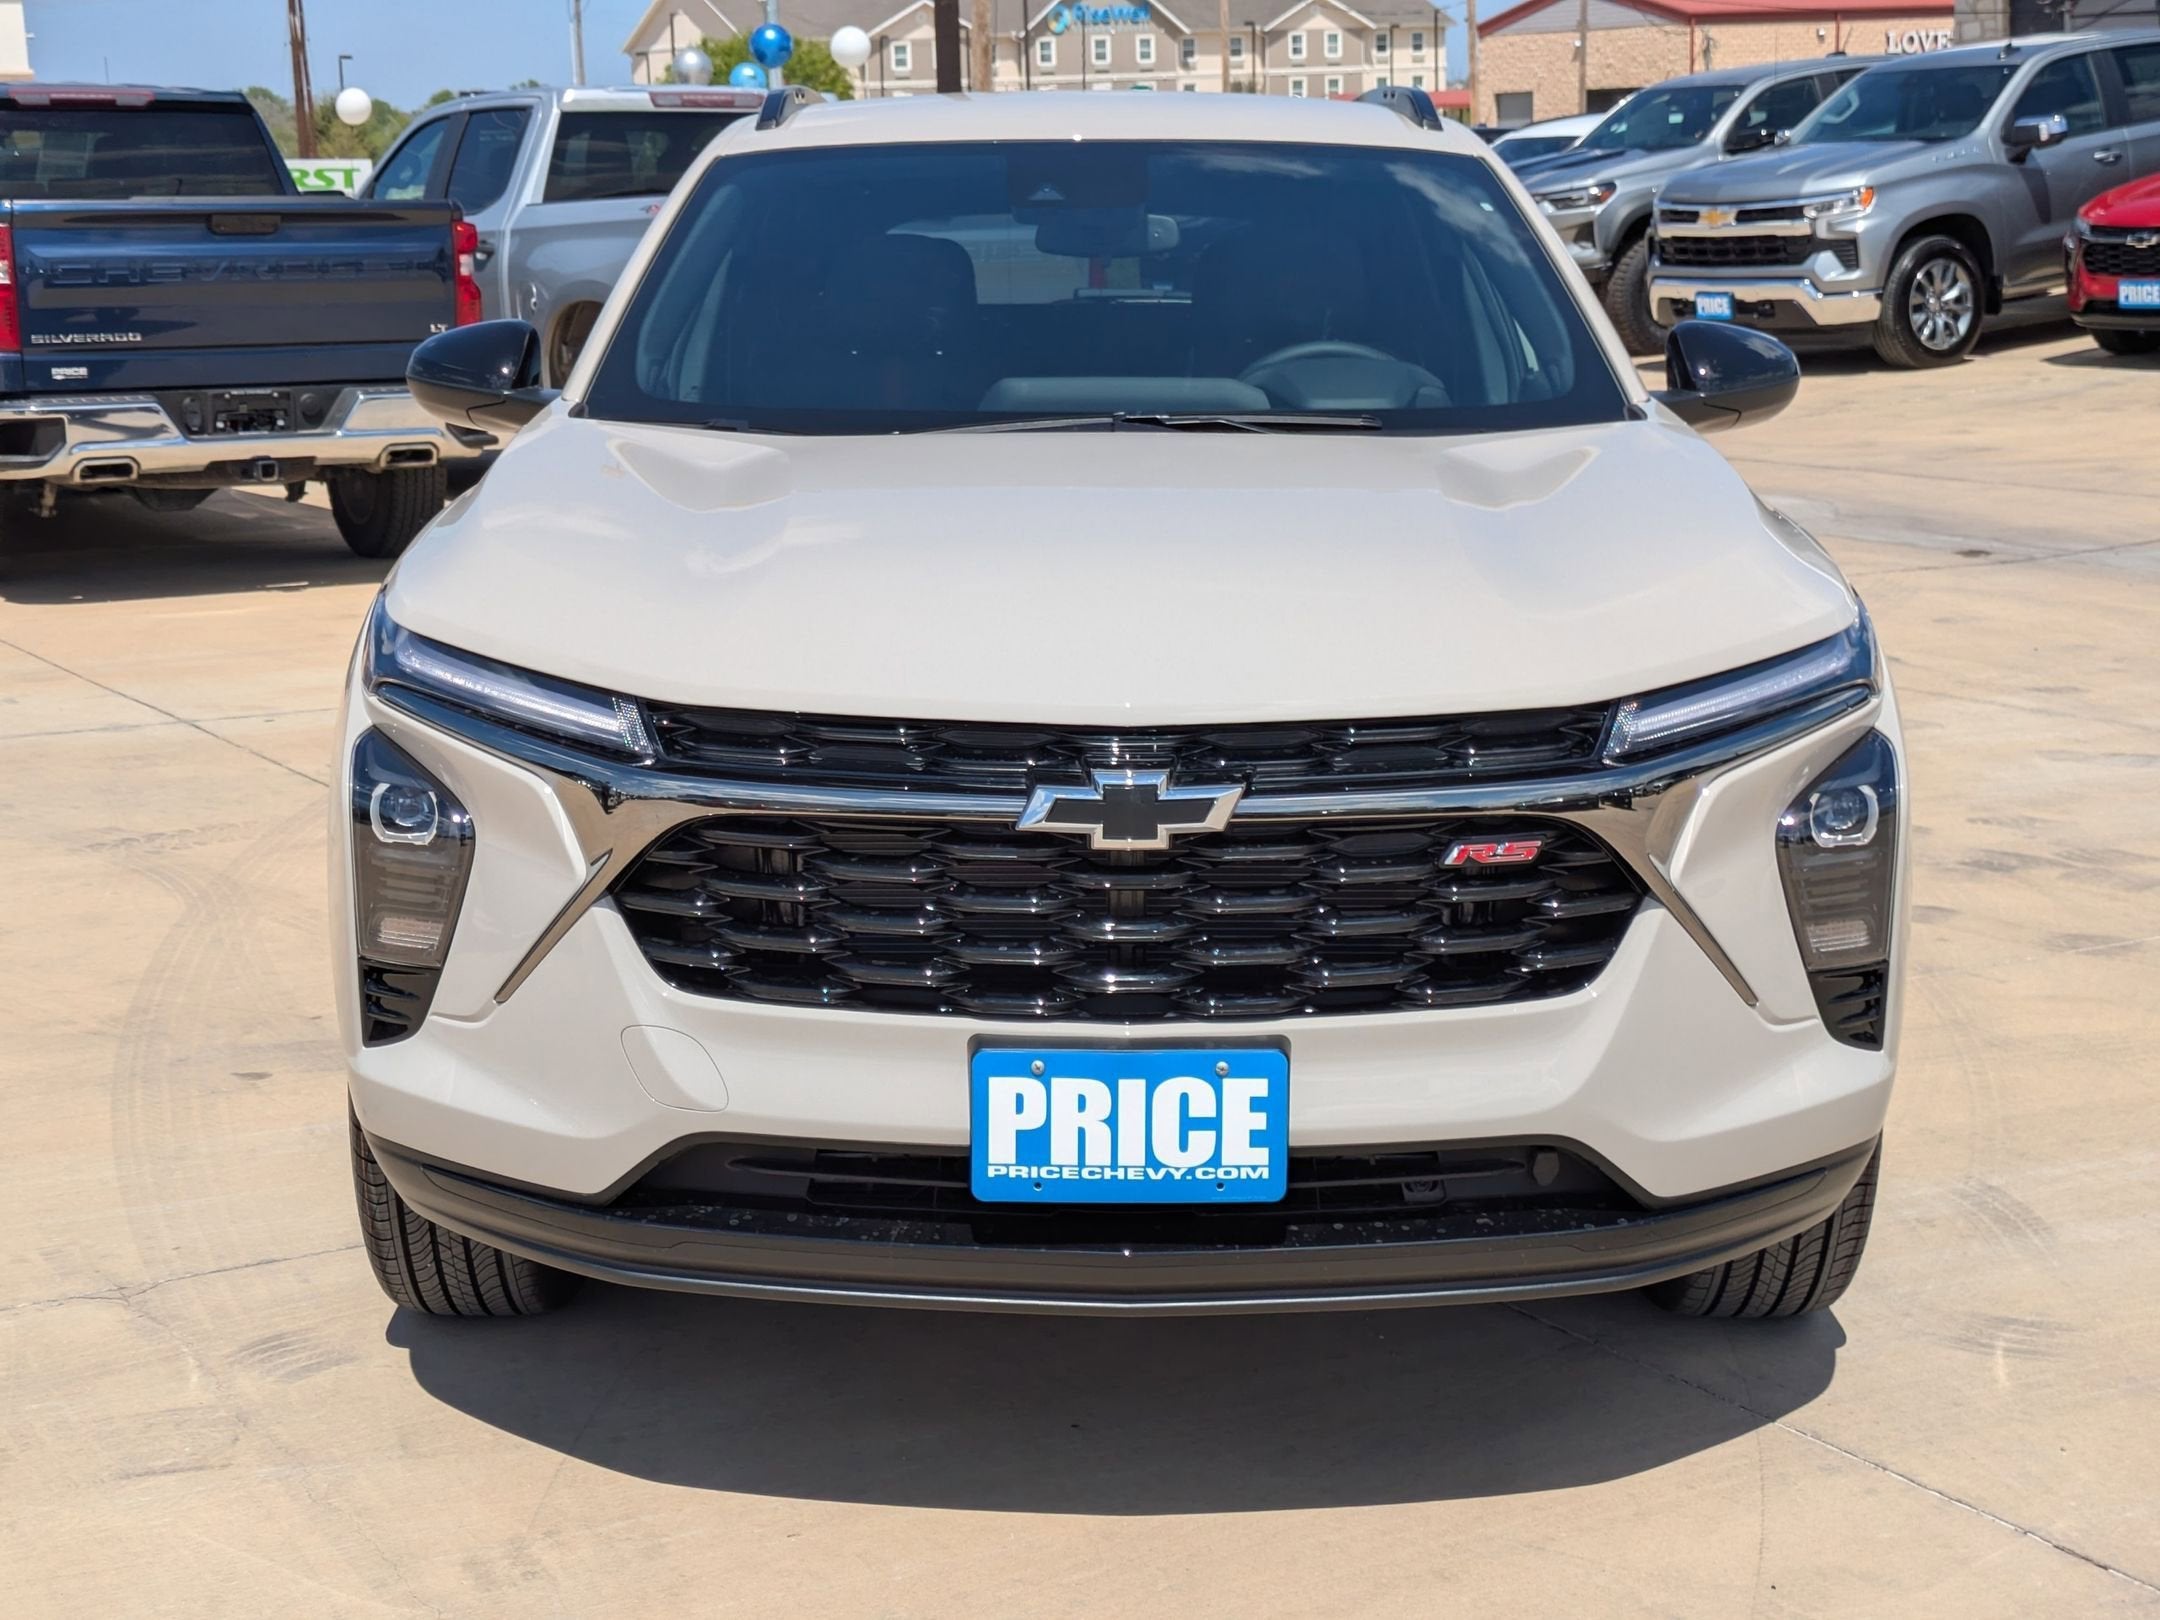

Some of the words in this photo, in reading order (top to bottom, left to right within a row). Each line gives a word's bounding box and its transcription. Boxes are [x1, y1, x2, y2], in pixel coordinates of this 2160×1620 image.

[50, 261, 422, 286] CHEVRO
[31, 332, 142, 343] SILVERADO
[1444, 841, 1541, 864] RS
[988, 1076, 1269, 1167] PRICE
[987, 1165, 1269, 1180] PRICECHEVY.COM
